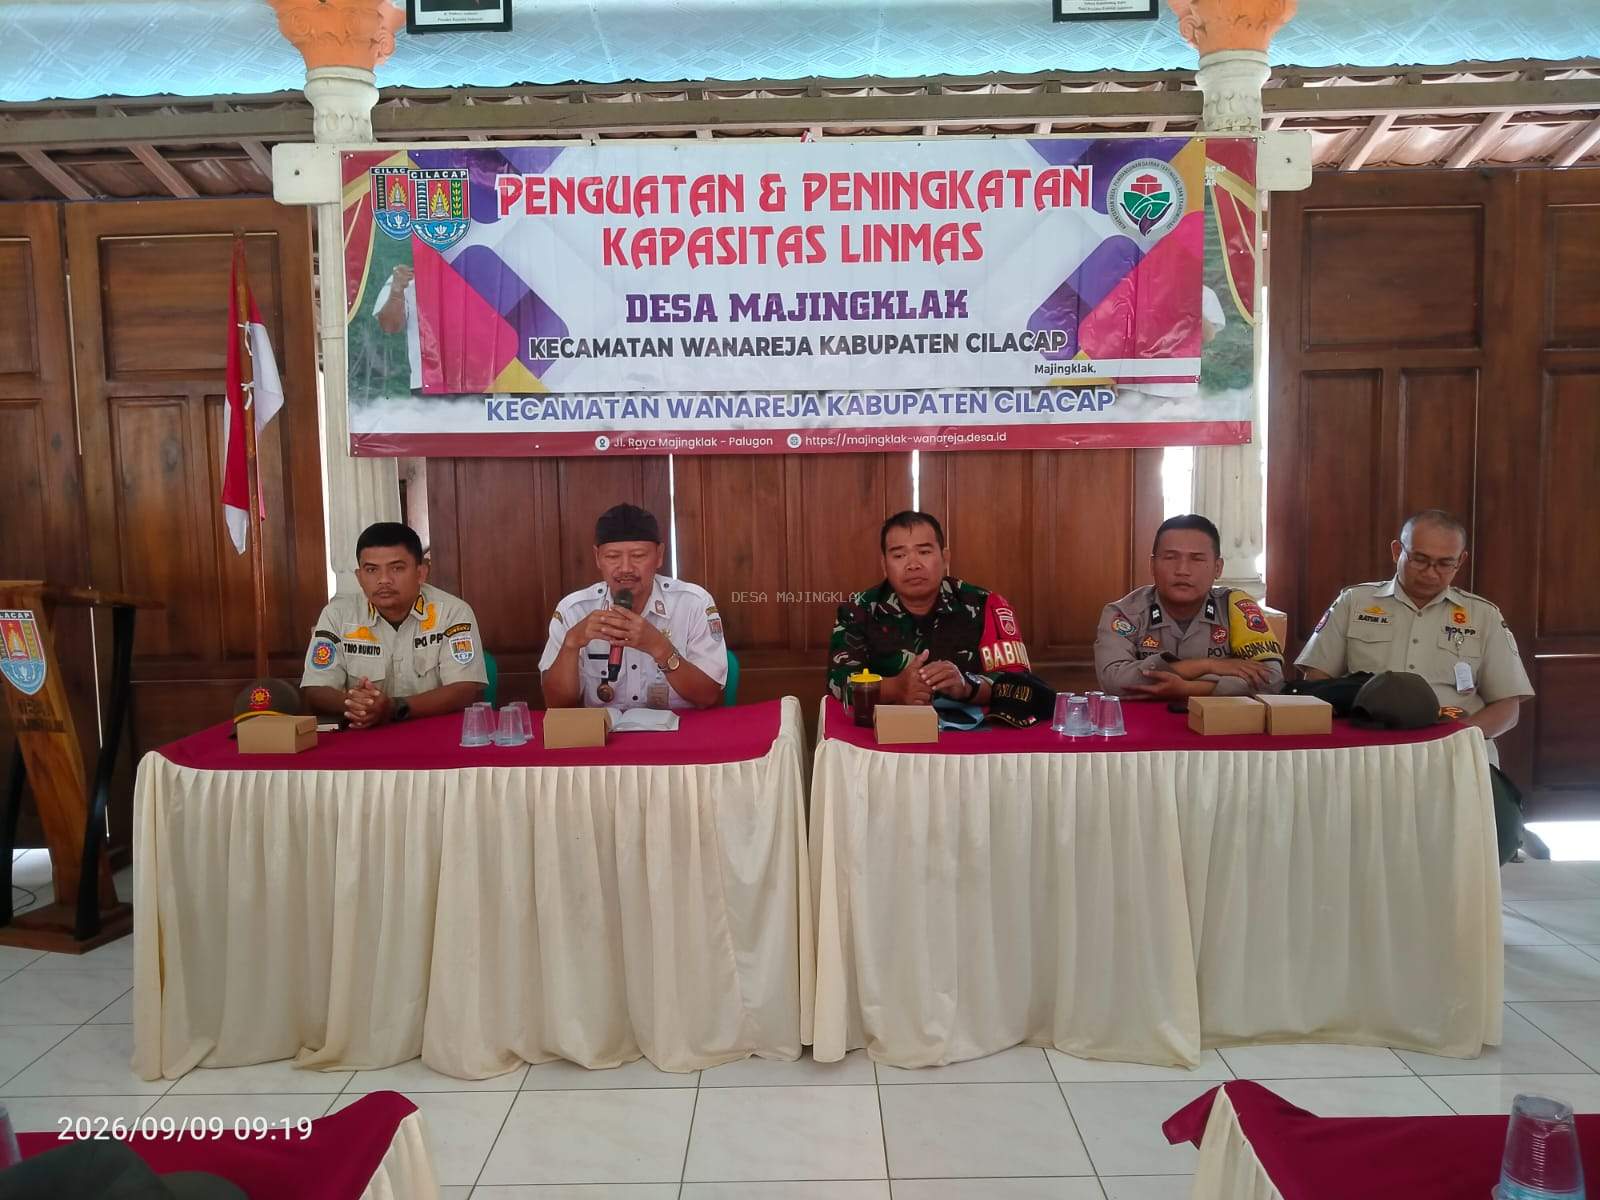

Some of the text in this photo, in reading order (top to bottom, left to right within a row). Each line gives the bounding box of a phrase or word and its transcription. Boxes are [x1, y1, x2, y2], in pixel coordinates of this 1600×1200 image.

[410, 170, 466, 179] CILACAP
[498, 173, 745, 218] PENGUATAN
[758, 173, 787, 213] &
[802, 168, 1090, 213] PENINGKATAN
[603, 222, 984, 270] KAPASITAS LINMAS
[625, 289, 969, 323] DESA MAJINGKLAK
[530, 330, 1067, 359] KECAMATAN WANAREJA KABUPATEN CILACAP
[487, 391, 1114, 421] KECAMATAN WANAREJA KABUPATEN CILACAP
[613, 436, 626, 448] Jl.
[628, 437, 656, 450] Raya
[658, 435, 718, 450] Majingklak
[728, 435, 773, 450] Palugon
[805, 432, 1007, 448] https://majingklak-wanareja.desa.id
